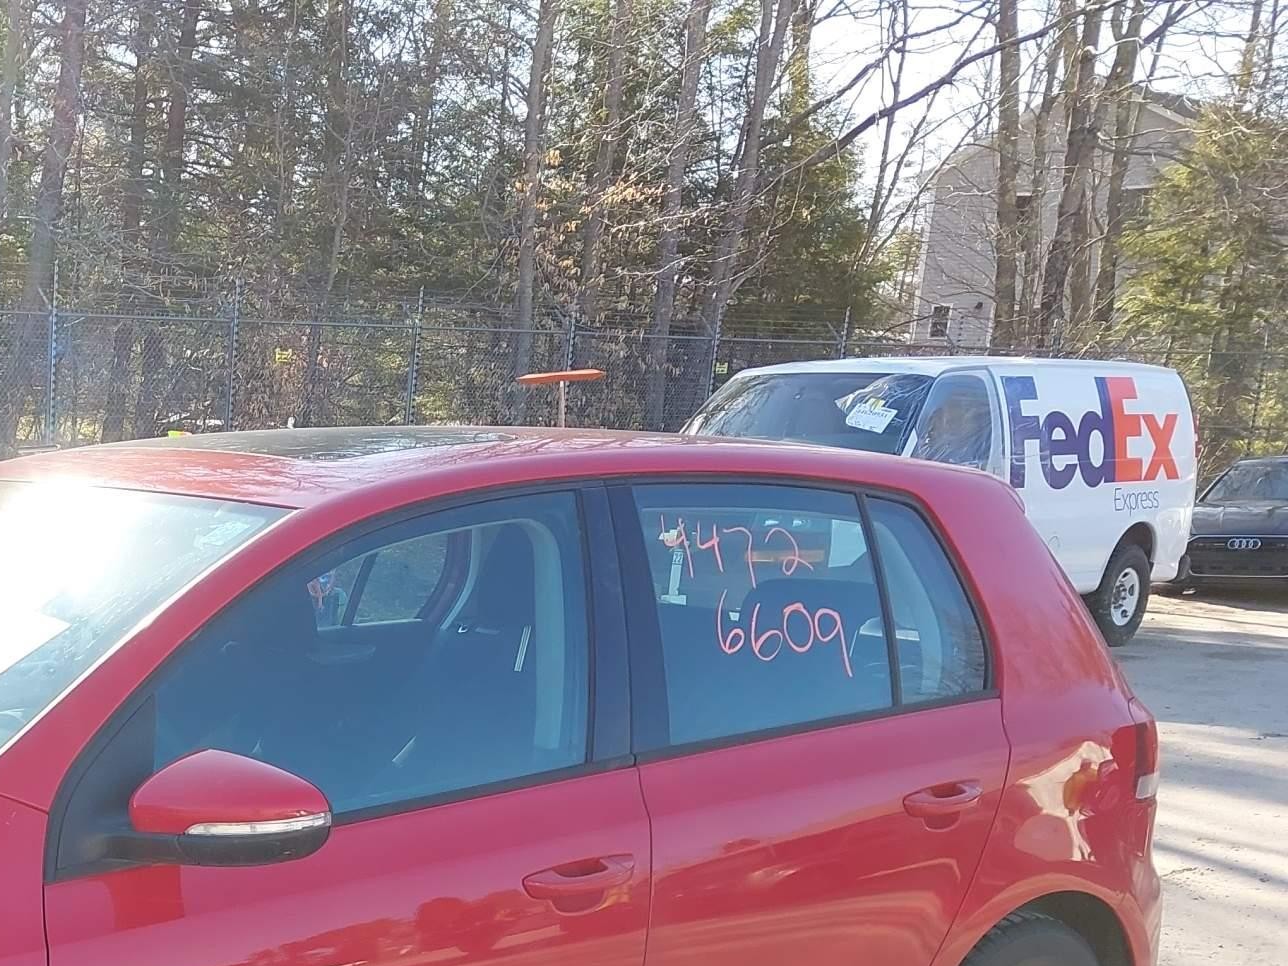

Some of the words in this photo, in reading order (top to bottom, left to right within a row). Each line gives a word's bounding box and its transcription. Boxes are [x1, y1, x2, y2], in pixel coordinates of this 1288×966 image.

[1000, 375, 1180, 490] FedEx
[1114, 487, 1160, 516] Express
[660, 514, 814, 589] 4472
[716, 588, 853, 678] 6609
